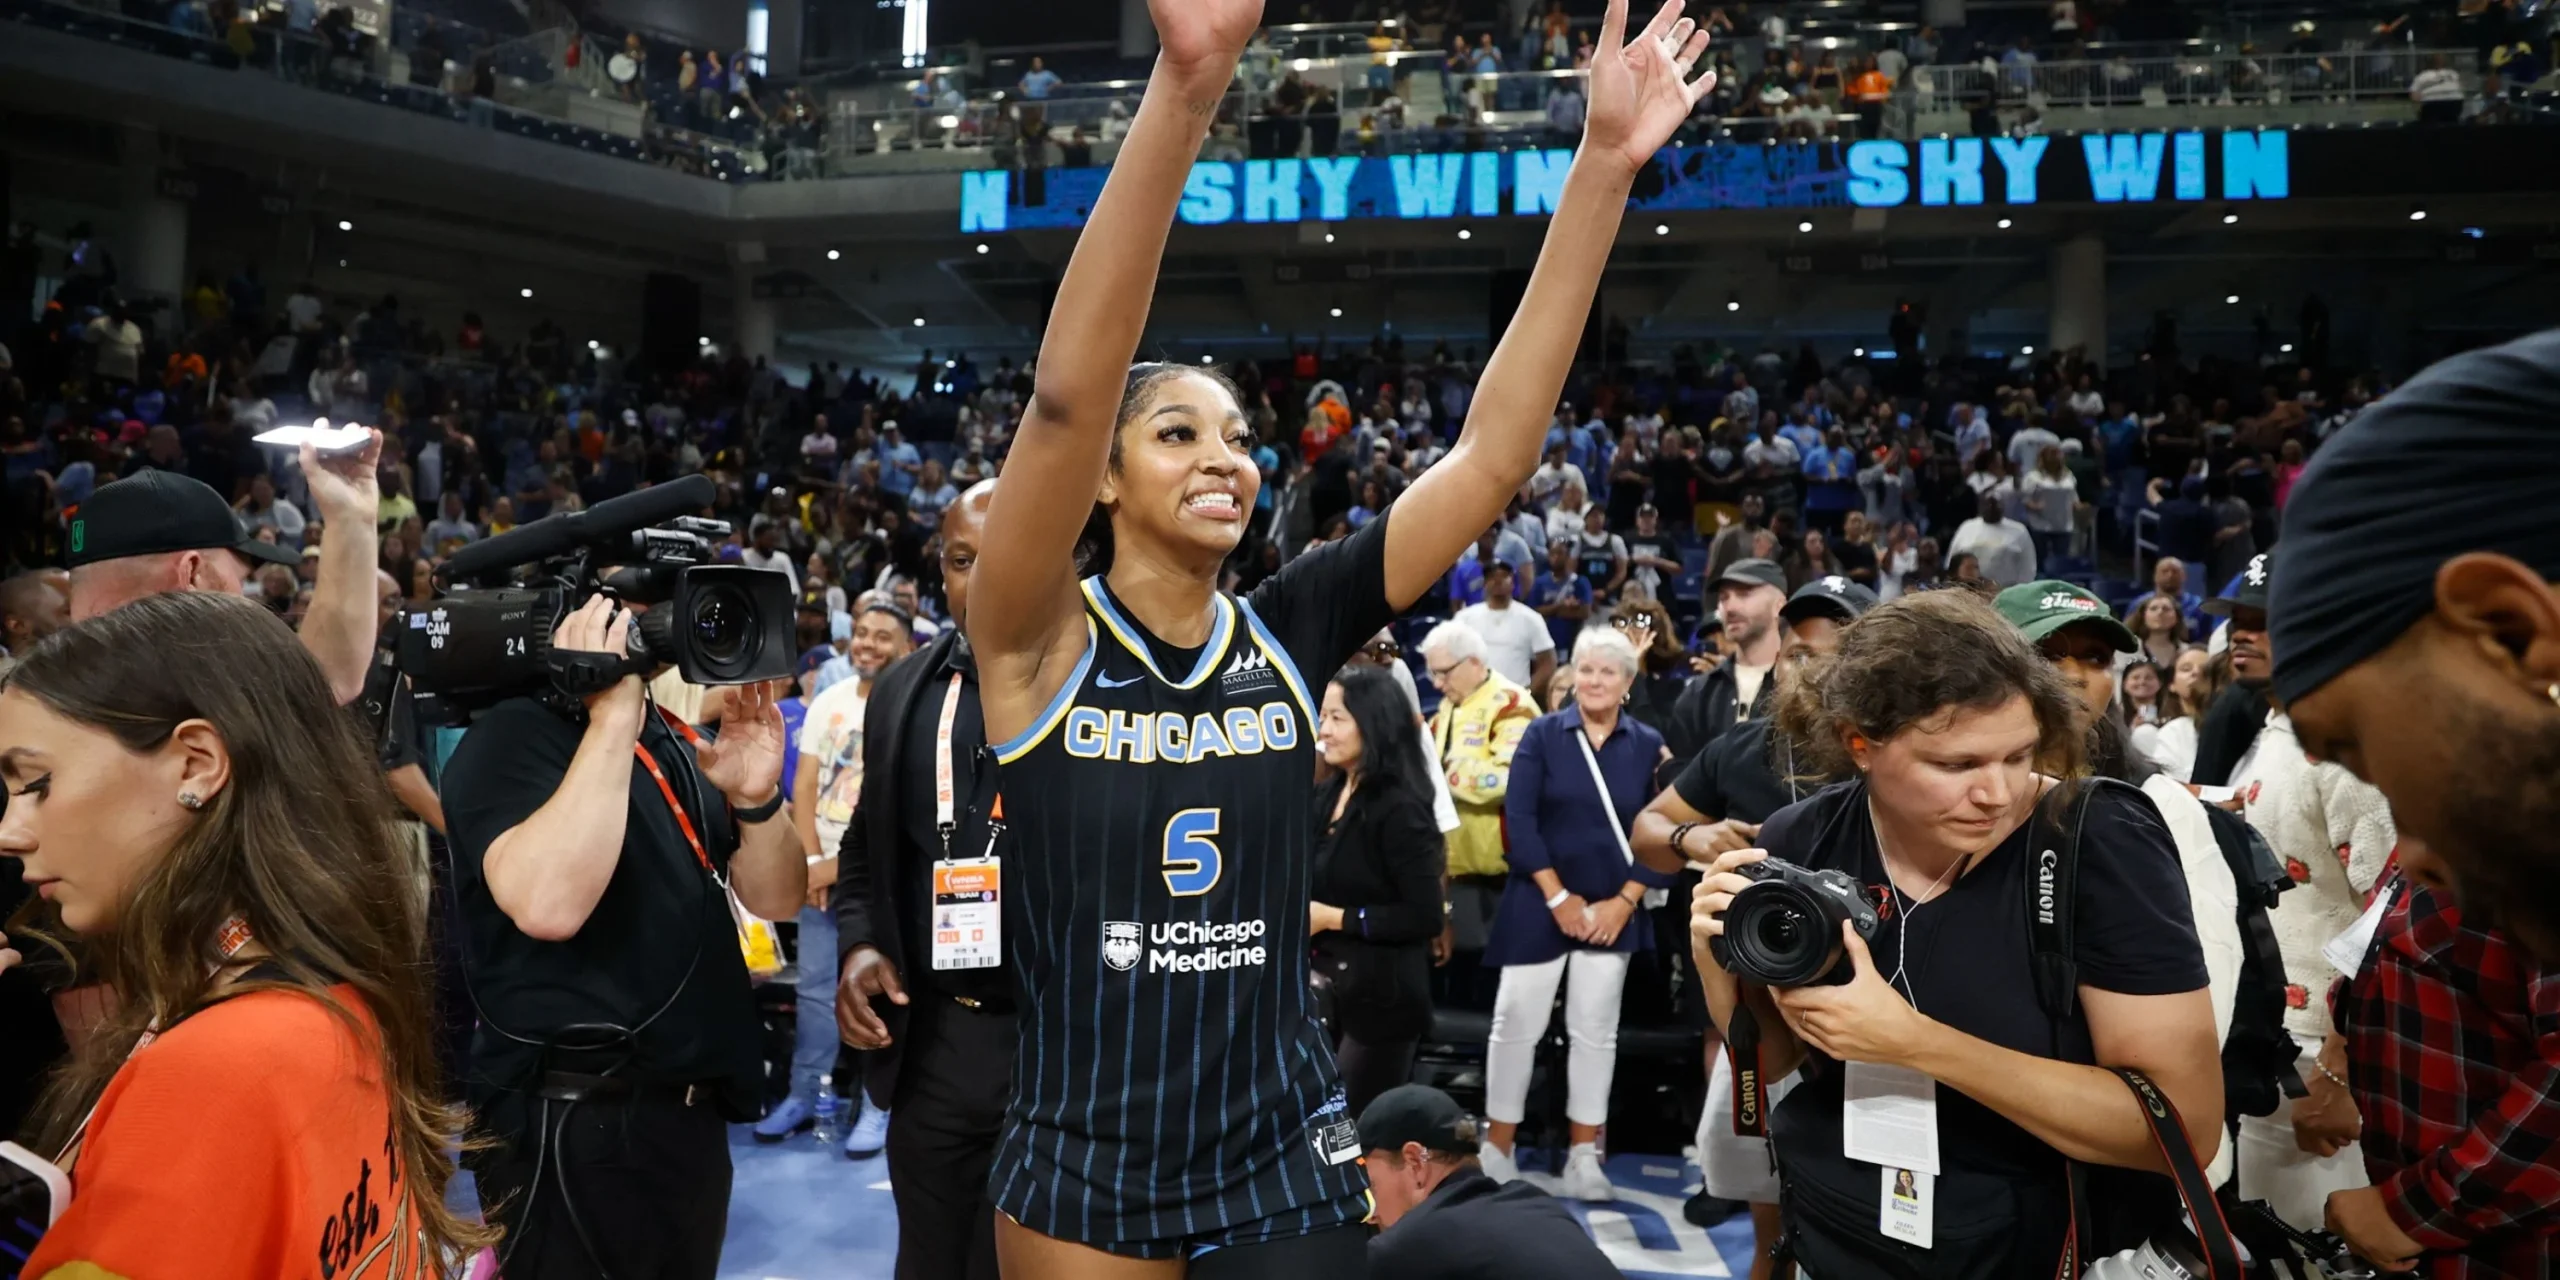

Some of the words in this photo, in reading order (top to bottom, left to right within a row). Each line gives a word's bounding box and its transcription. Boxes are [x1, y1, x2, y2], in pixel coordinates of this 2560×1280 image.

[1180, 156, 1362, 226] SKY
[1390, 149, 1574, 219] WIN
[1847, 137, 2049, 207] SKY
[2083, 131, 2289, 203] WIN
[426, 621, 450, 636] CAM
[501, 611, 526, 621] SONY
[431, 636, 444, 649] 09
[1222, 671, 1275, 686] MAGELLAN
[1064, 701, 1298, 764] CHICAGO
[1161, 807, 1222, 897] 5
[2039, 849, 2058, 925] Canon
[1150, 918, 1266, 944] UChicago
[1149, 944, 1267, 974] Medicine
[1741, 1070, 1757, 1126] Canon
